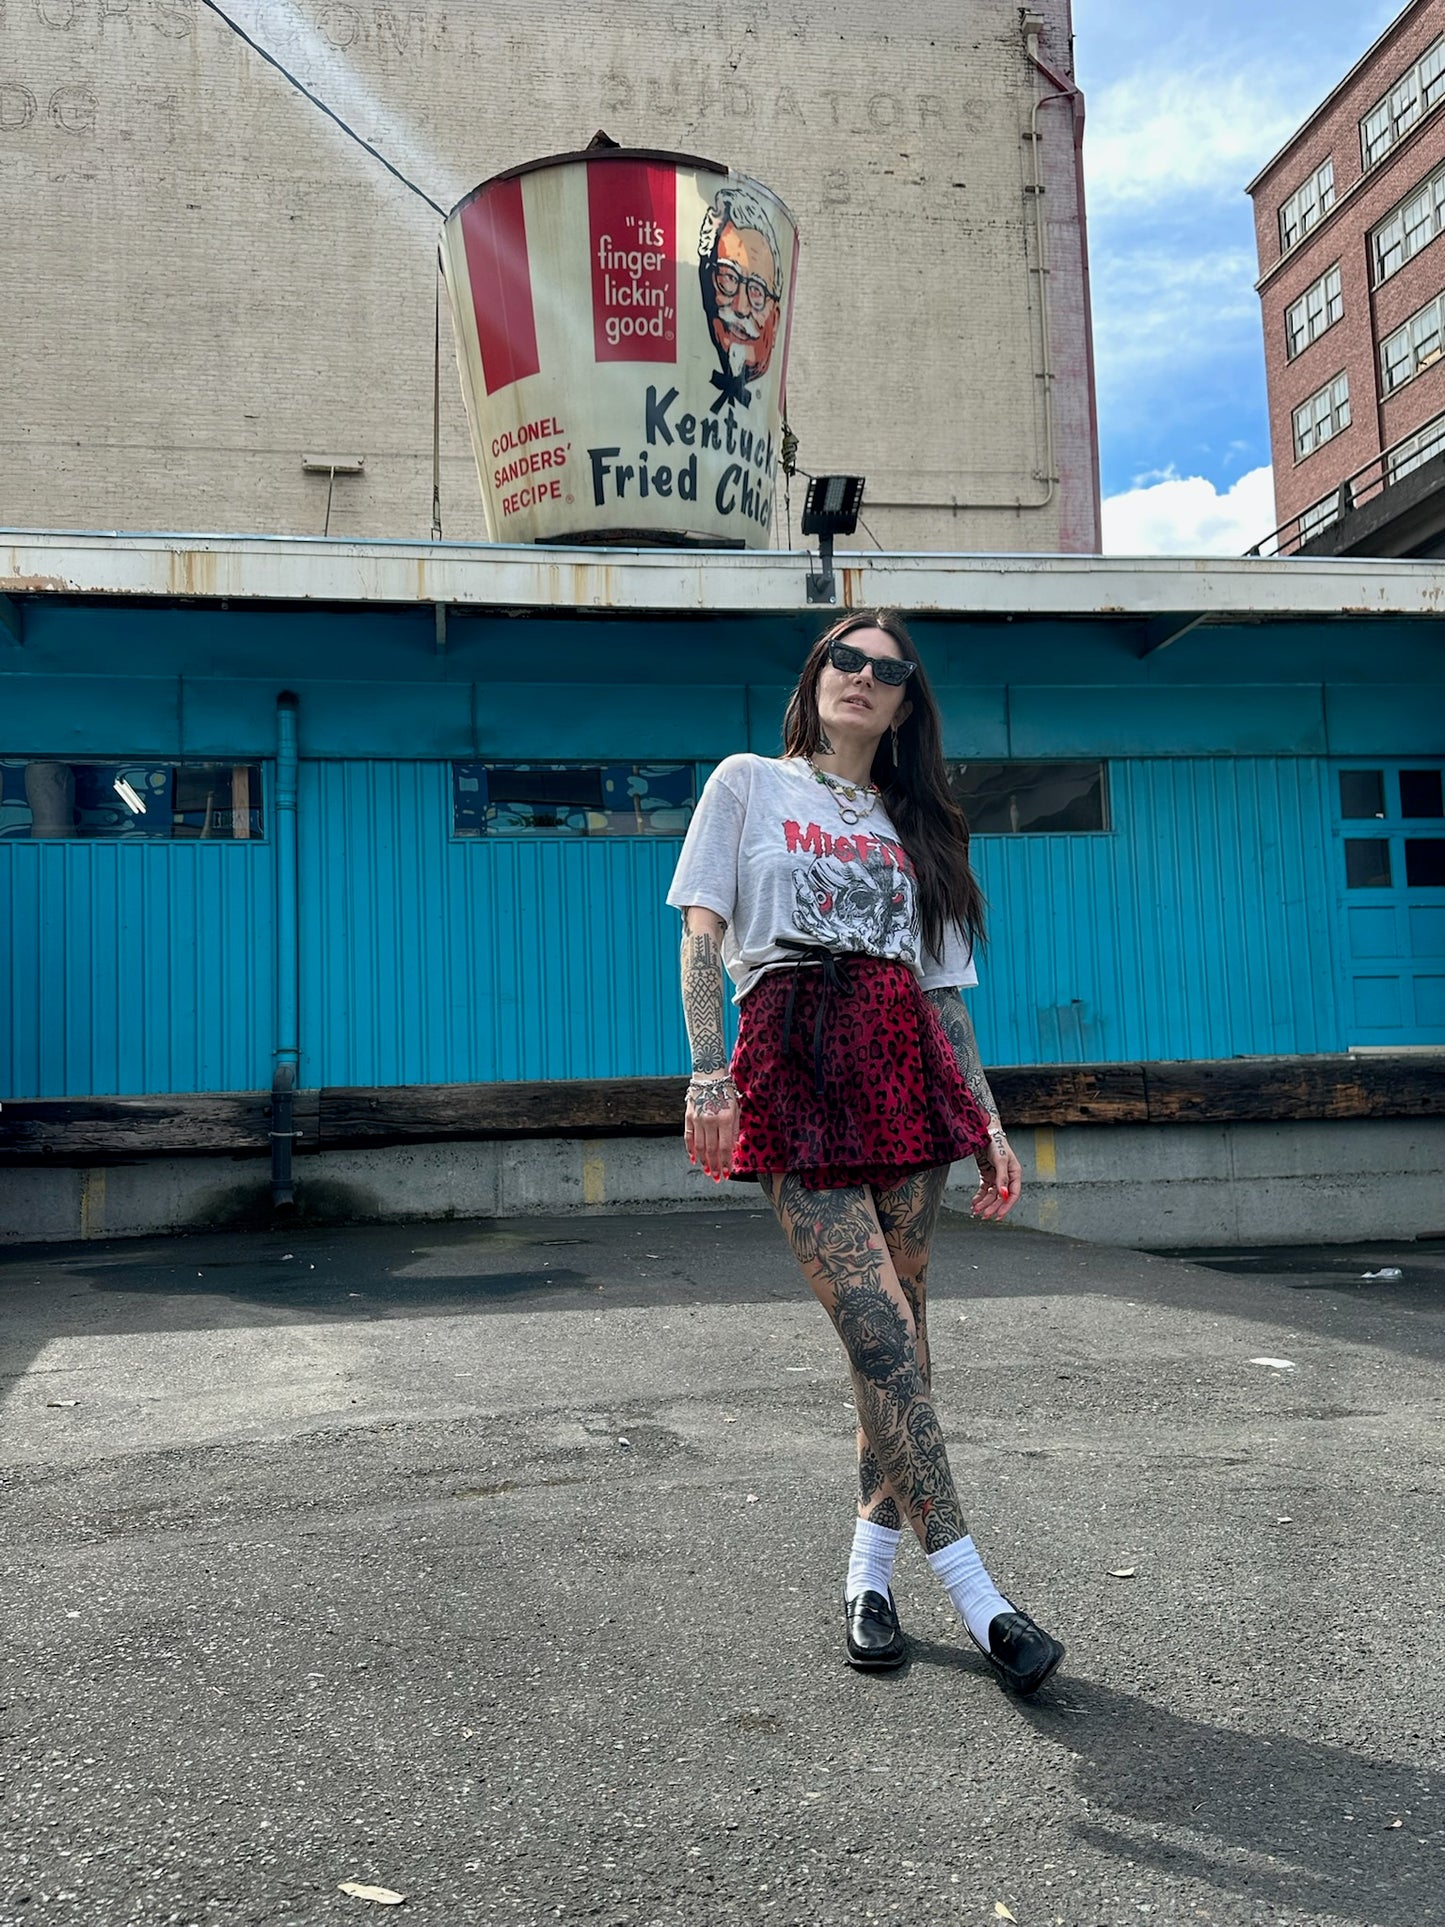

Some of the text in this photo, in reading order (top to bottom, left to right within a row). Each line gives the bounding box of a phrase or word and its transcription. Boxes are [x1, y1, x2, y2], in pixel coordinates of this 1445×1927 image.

[625, 216, 665, 247] "it's
[597, 234, 666, 279] finger
[604, 273, 669, 307] lickin'
[605, 306, 674, 345] good"
[491, 416, 565, 458] COLONEL
[645, 384, 778, 481] Kentuck
[494, 442, 571, 489] SANDERS'
[502, 479, 562, 517] RECIPE
[586, 447, 774, 531] Fried Chic
